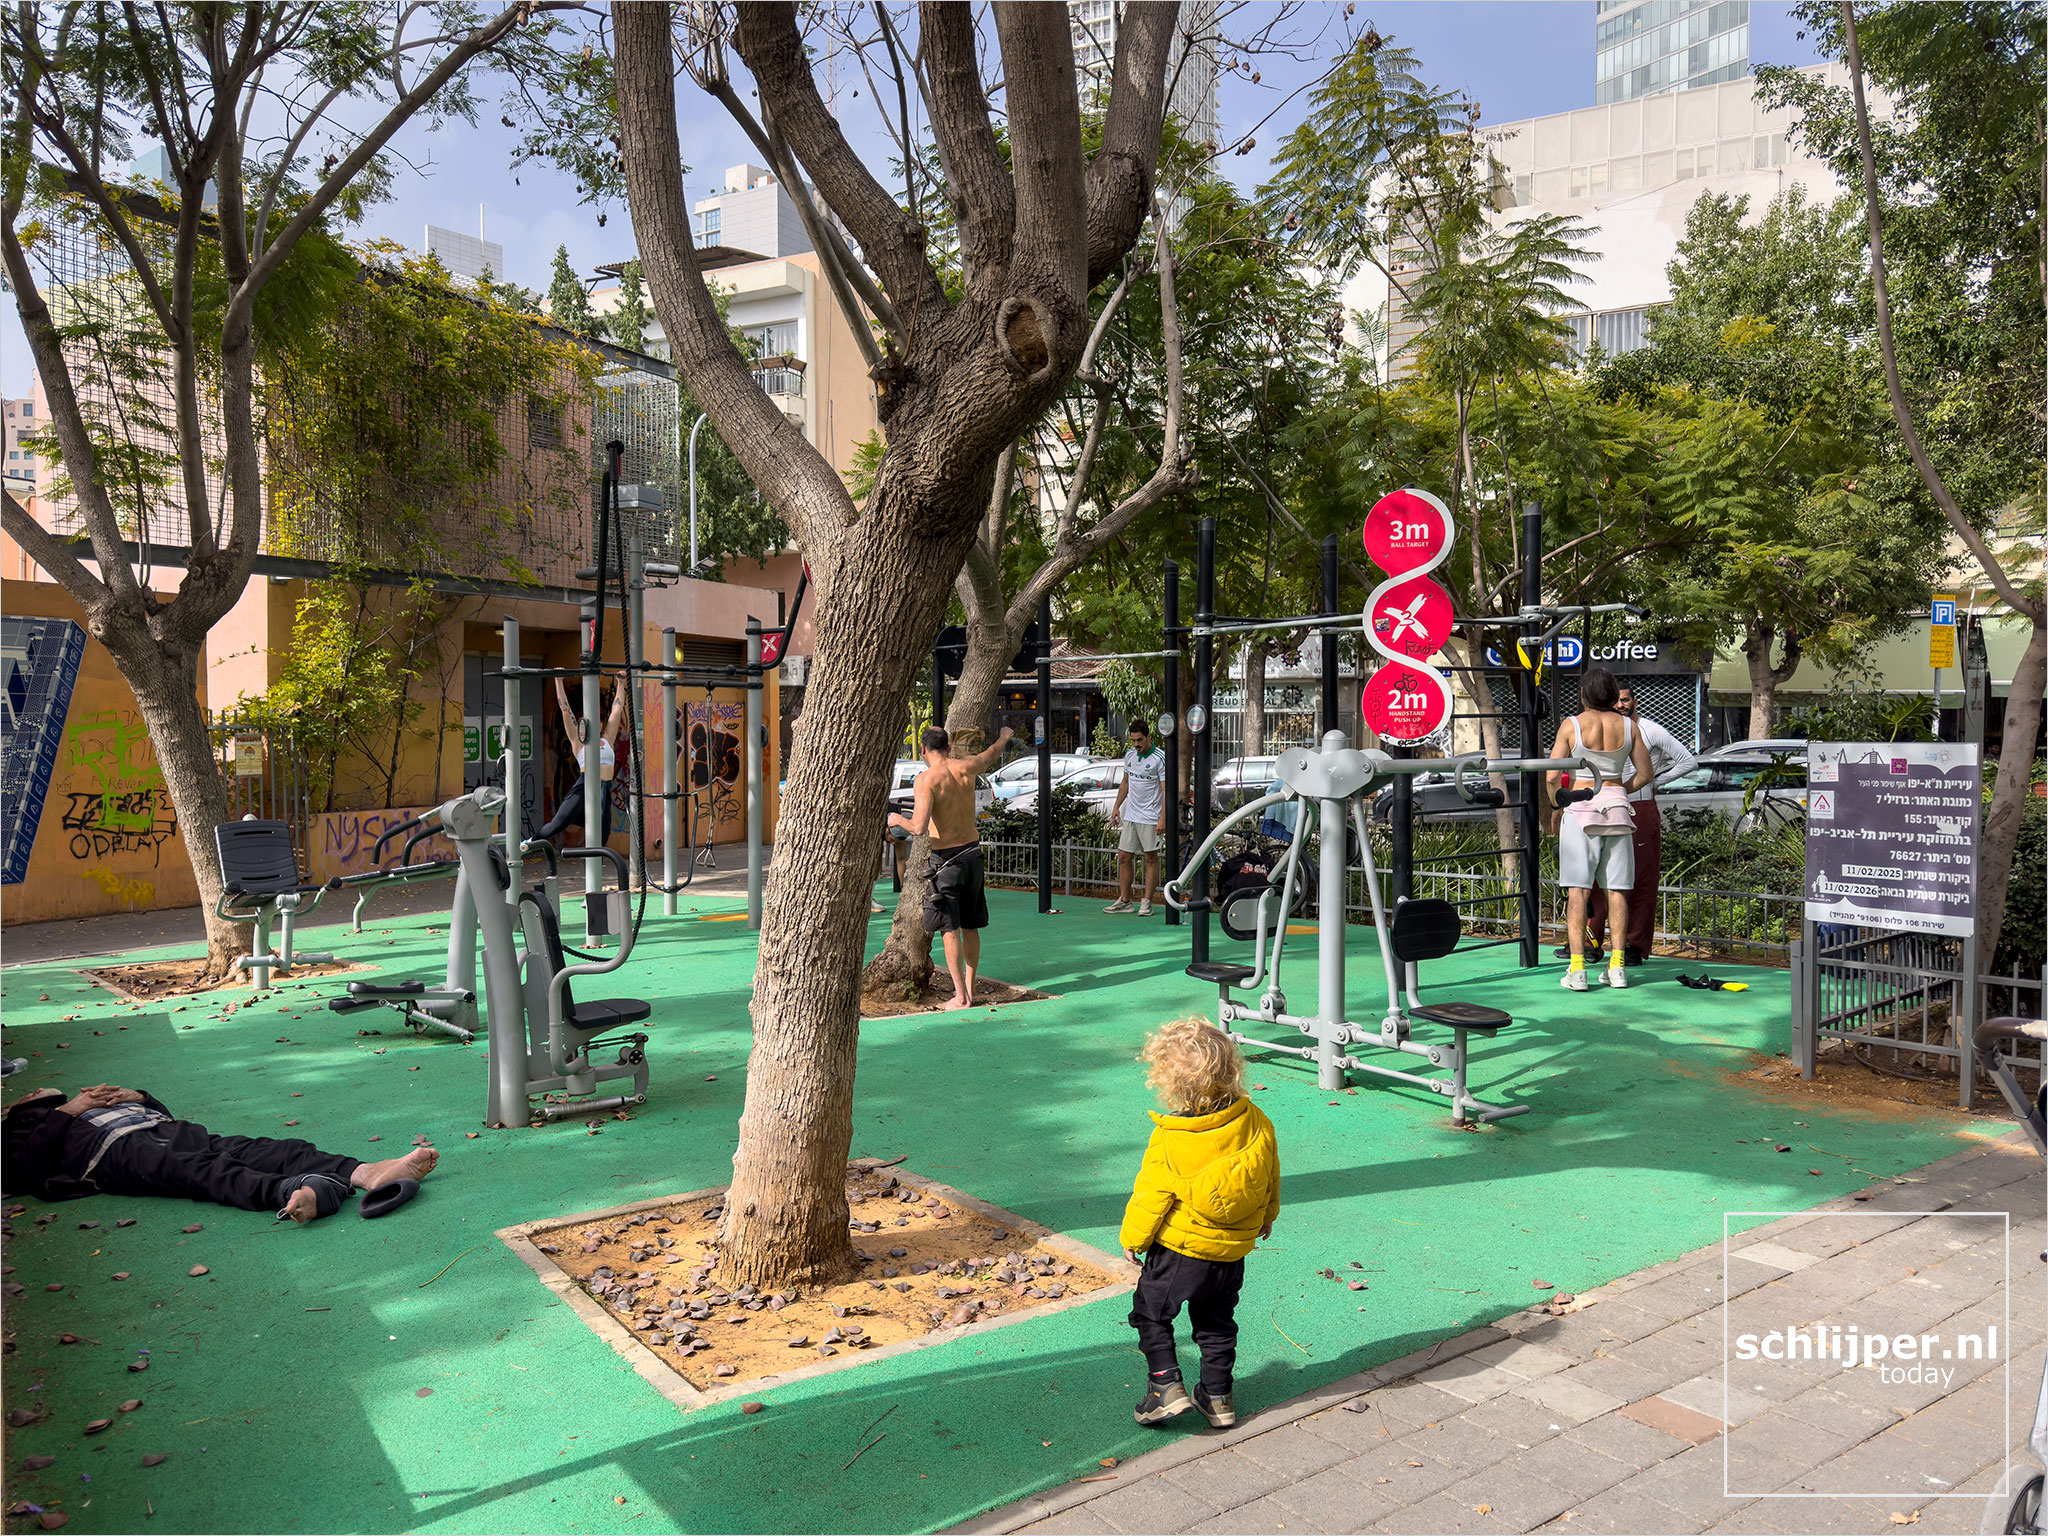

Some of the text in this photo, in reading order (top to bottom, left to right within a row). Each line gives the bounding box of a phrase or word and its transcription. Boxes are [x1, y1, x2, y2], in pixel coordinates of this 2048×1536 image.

[1389, 520, 1429, 540] 3m
[1590, 639, 1657, 660] coffee
[1388, 689, 1427, 709] 2m
[1944, 780, 1972, 791] עיריית
[1876, 793, 1972, 807] כתובת האתר: ברזילי 7
[1904, 814, 1972, 828] קוד האתר: 155
[1878, 831, 1914, 843] עיריית
[1916, 833, 1972, 846] בתחזוקת
[1890, 850, 1921, 862] 76627
[1923, 852, 1950, 863] היתר:
[1846, 866, 1970, 885] ביקורת שנתית: 11/02/2025
[1824, 882, 1970, 906] ביקורת שנתית הבאה: 11/02/2026
[1884, 916, 1902, 924] פלוס
[1922, 920, 1945, 930] שירות
